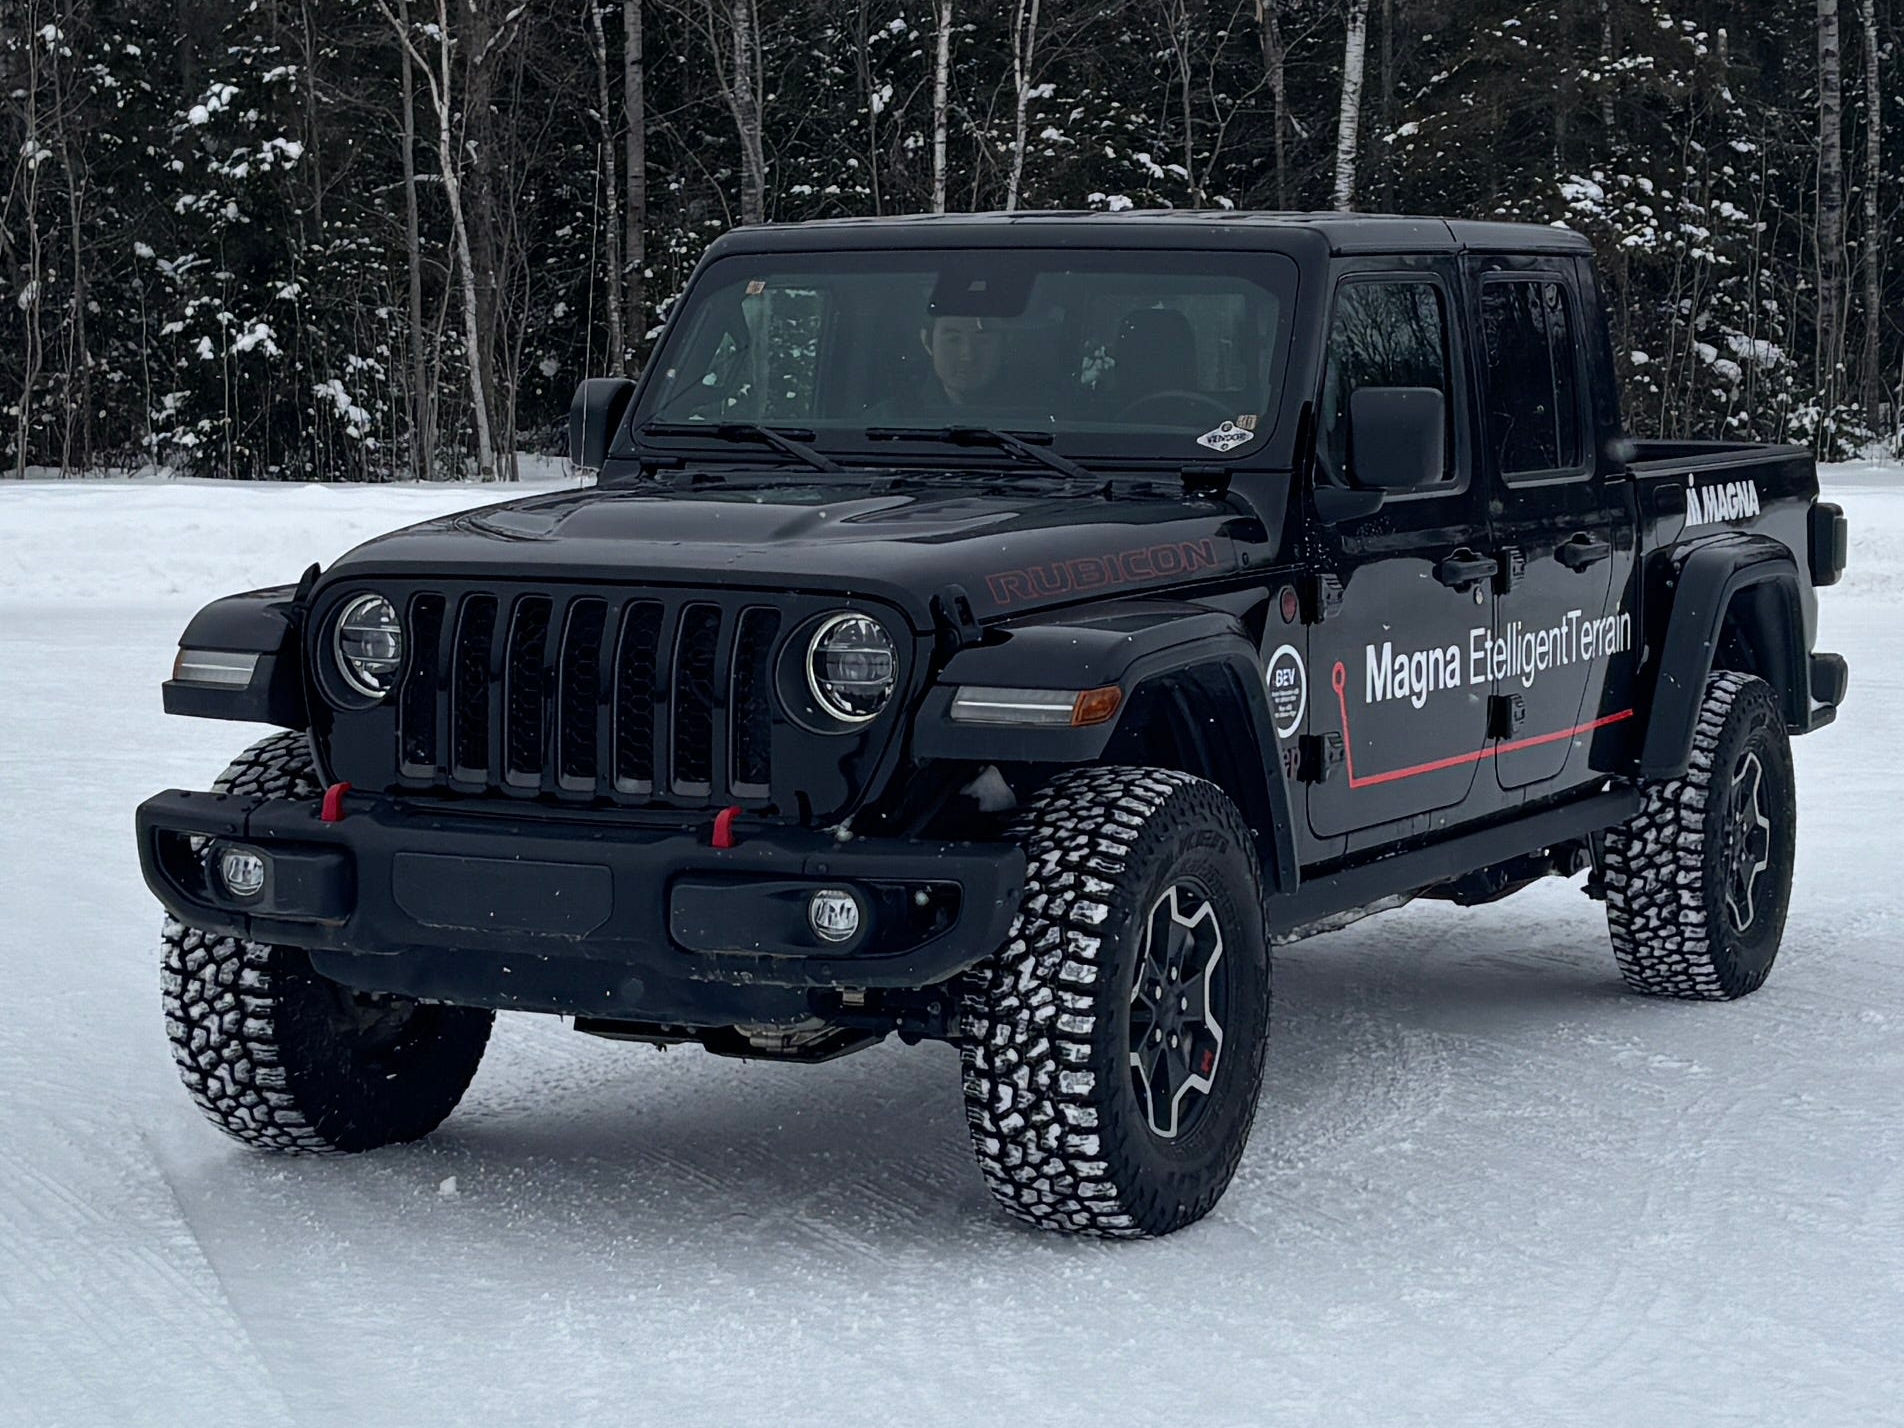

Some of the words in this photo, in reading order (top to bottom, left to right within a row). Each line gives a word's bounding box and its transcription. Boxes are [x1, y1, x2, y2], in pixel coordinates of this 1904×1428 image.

[1701, 479, 1760, 524] MAGNA
[985, 538, 1218, 605] RUBICON
[1276, 668, 1296, 687] BEV
[1365, 641, 1461, 709] Magna
[1469, 601, 1631, 689] EtelligentTerrain
